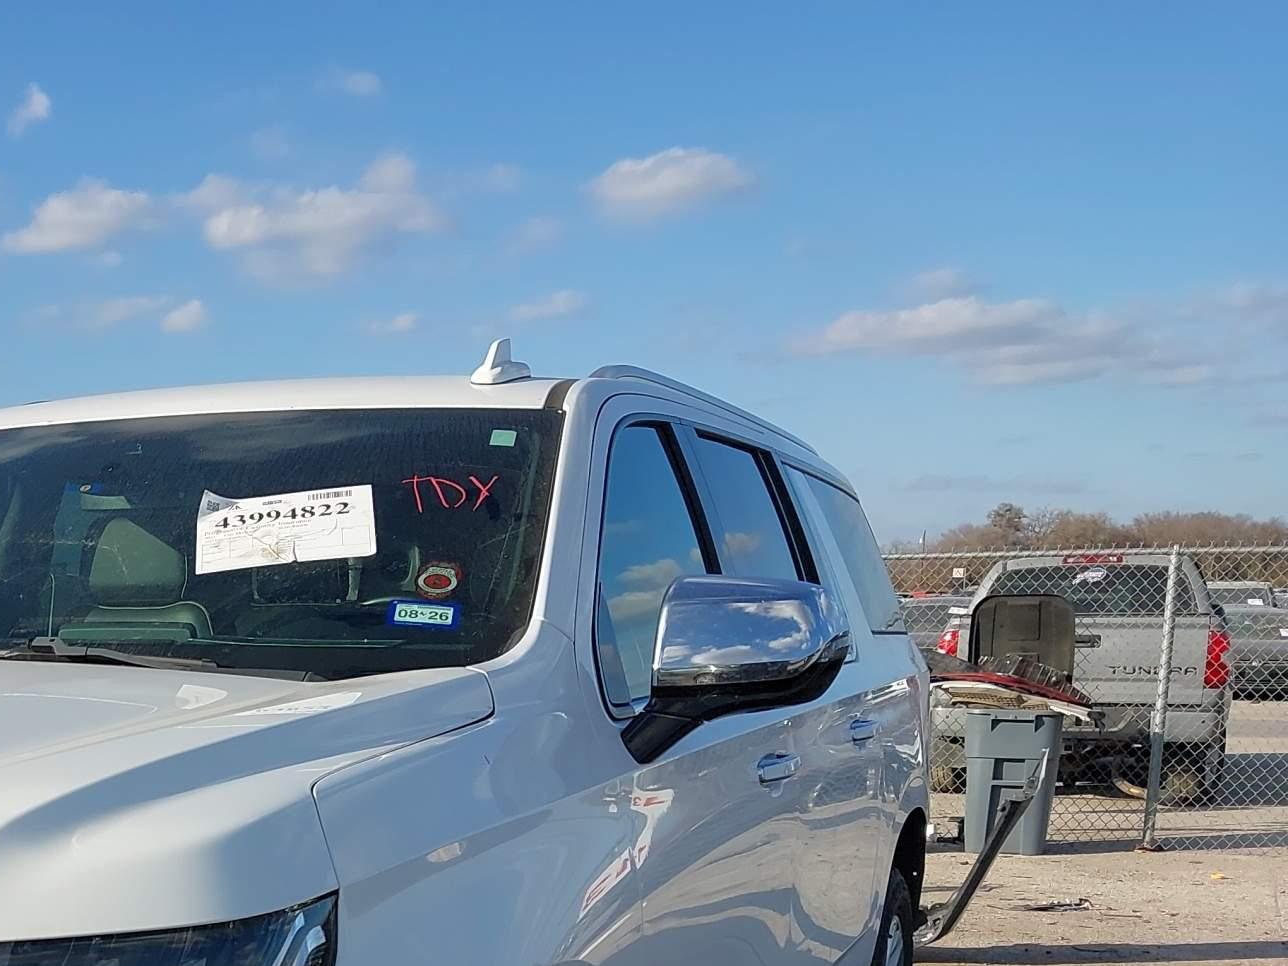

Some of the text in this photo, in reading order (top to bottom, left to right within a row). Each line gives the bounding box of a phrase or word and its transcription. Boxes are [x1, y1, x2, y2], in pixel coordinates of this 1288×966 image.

[215, 501, 350, 529] 43994822
[398, 608, 419, 619] 08
[428, 610, 450, 621] 26
